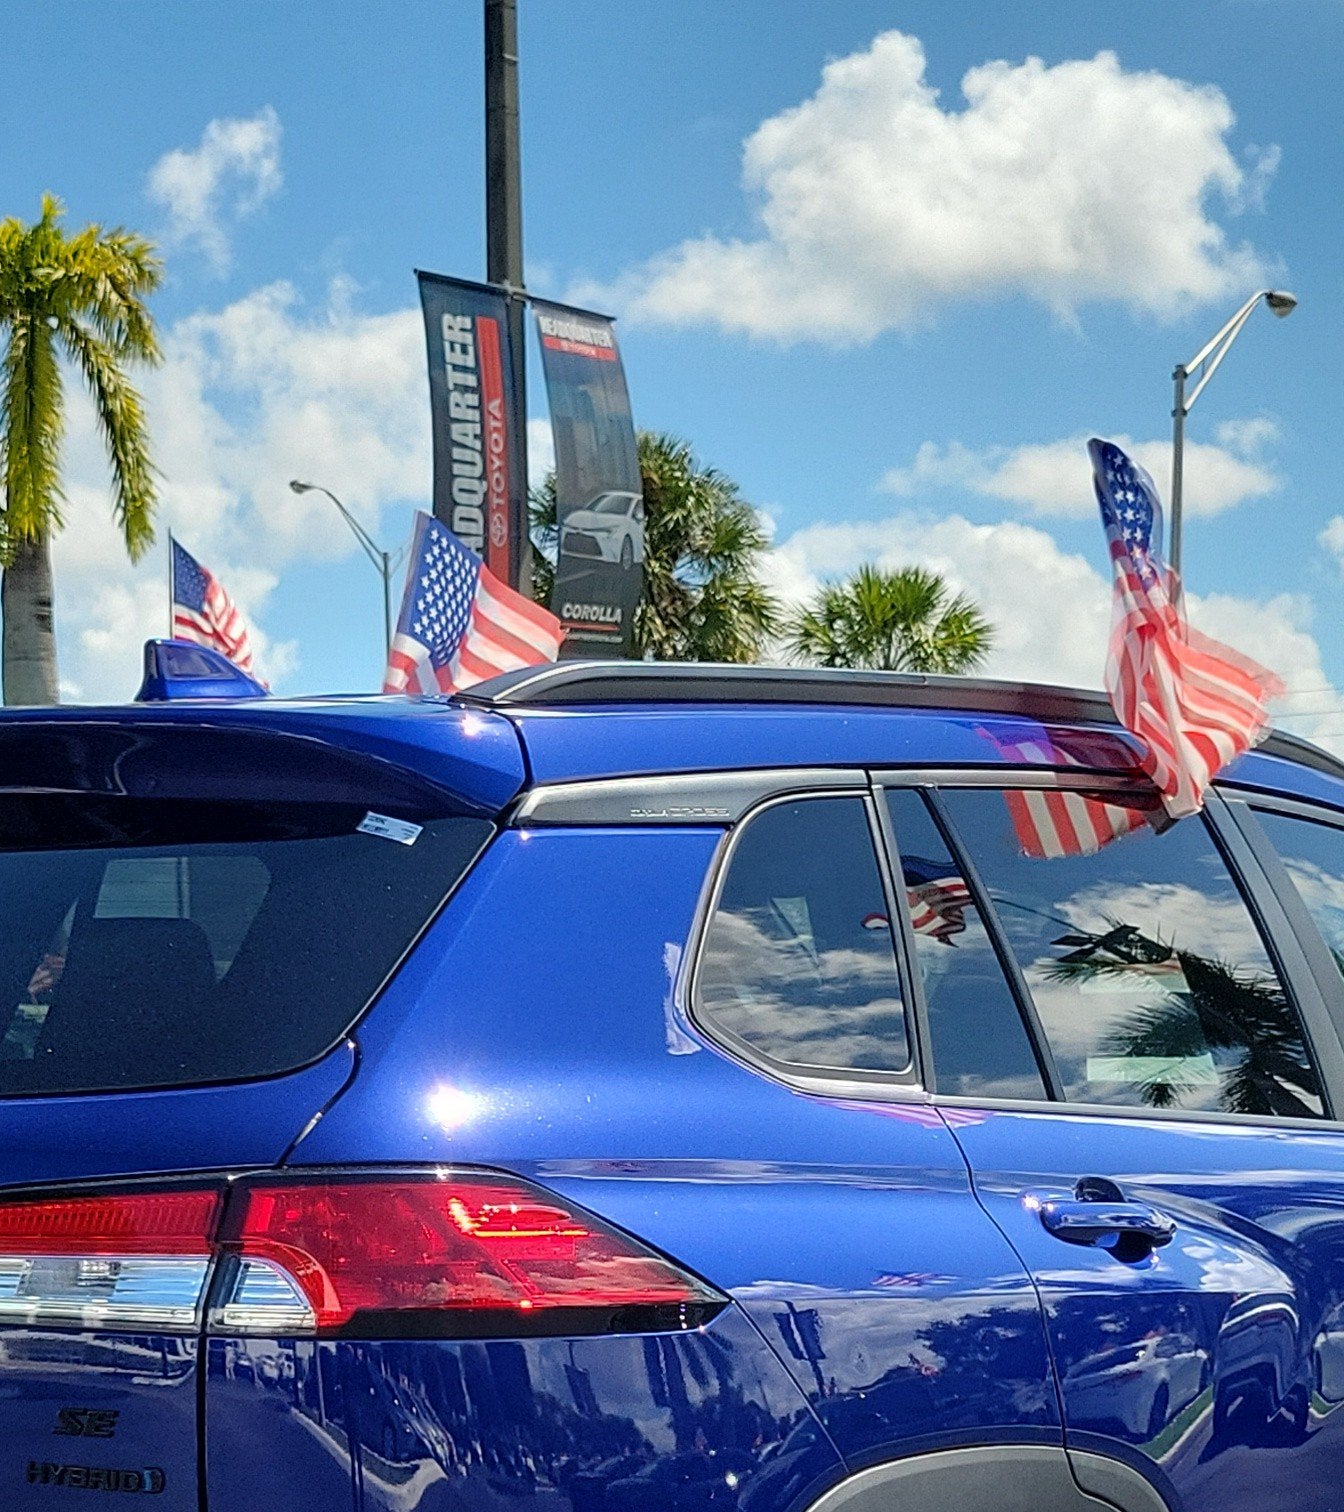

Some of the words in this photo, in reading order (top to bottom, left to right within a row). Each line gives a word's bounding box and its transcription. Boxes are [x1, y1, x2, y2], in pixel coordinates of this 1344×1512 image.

[442, 313, 486, 561] ADQUARTER
[488, 399, 505, 510] TOYOTA
[562, 602, 623, 623] COROLLA
[52, 1407, 121, 1439] SE
[26, 1460, 142, 1493] HYBRID
